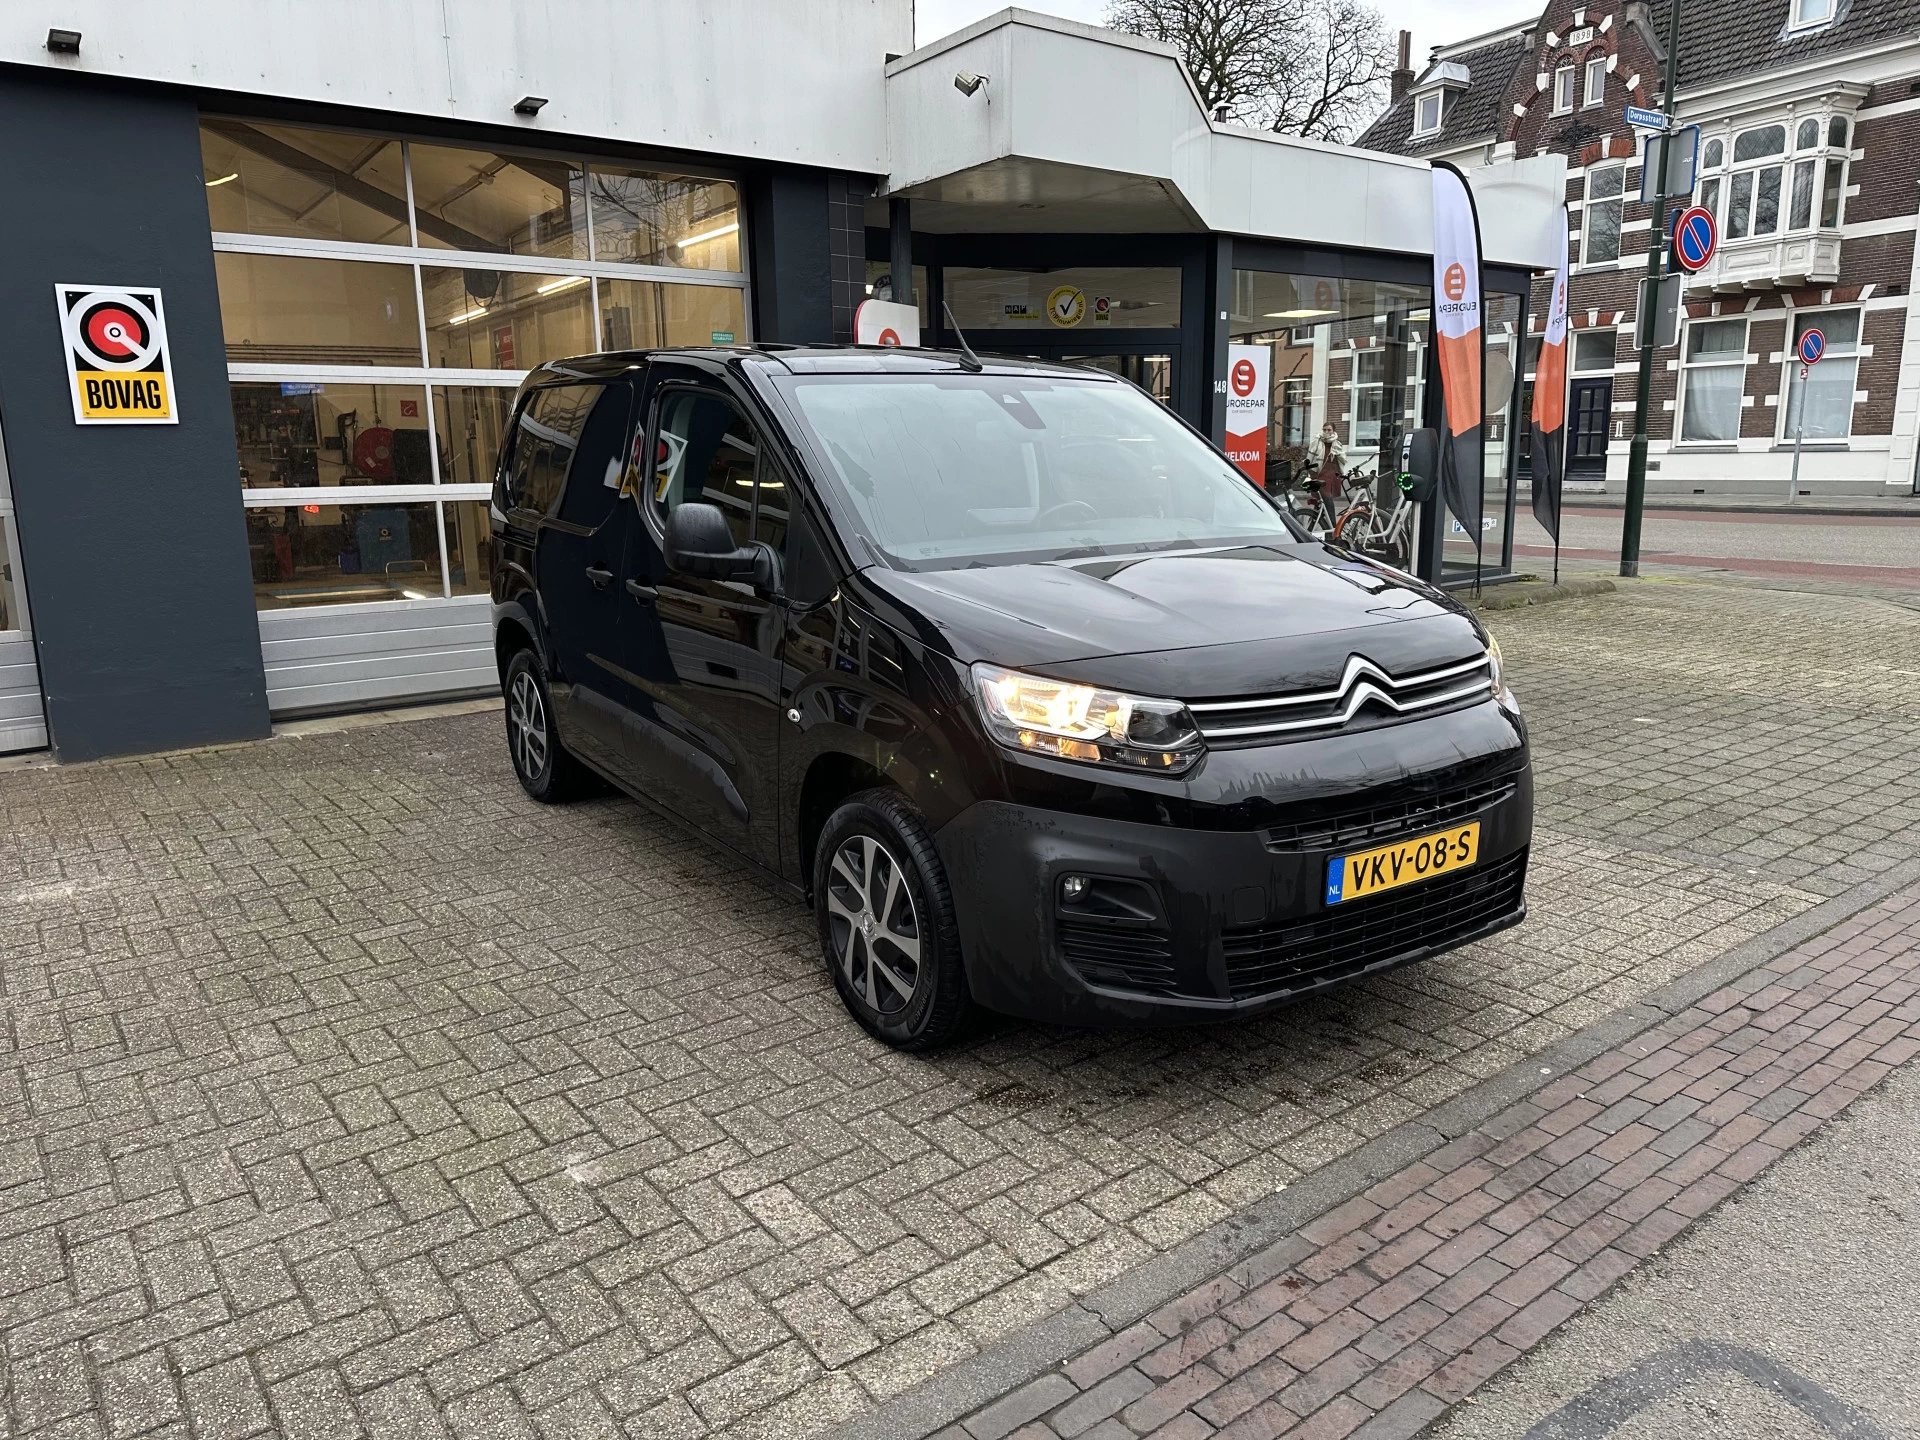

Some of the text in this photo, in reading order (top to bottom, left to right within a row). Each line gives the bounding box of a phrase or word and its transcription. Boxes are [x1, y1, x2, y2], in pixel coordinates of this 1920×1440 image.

[1630, 110, 1662, 125] Dorpsstraat
[85, 379, 162, 409] BOVAG
[1214, 380, 1227, 394] 148
[1226, 399, 1265, 408] UROREPAR
[1353, 830, 1471, 891] VKV-08-S
[1328, 885, 1340, 896] NL
